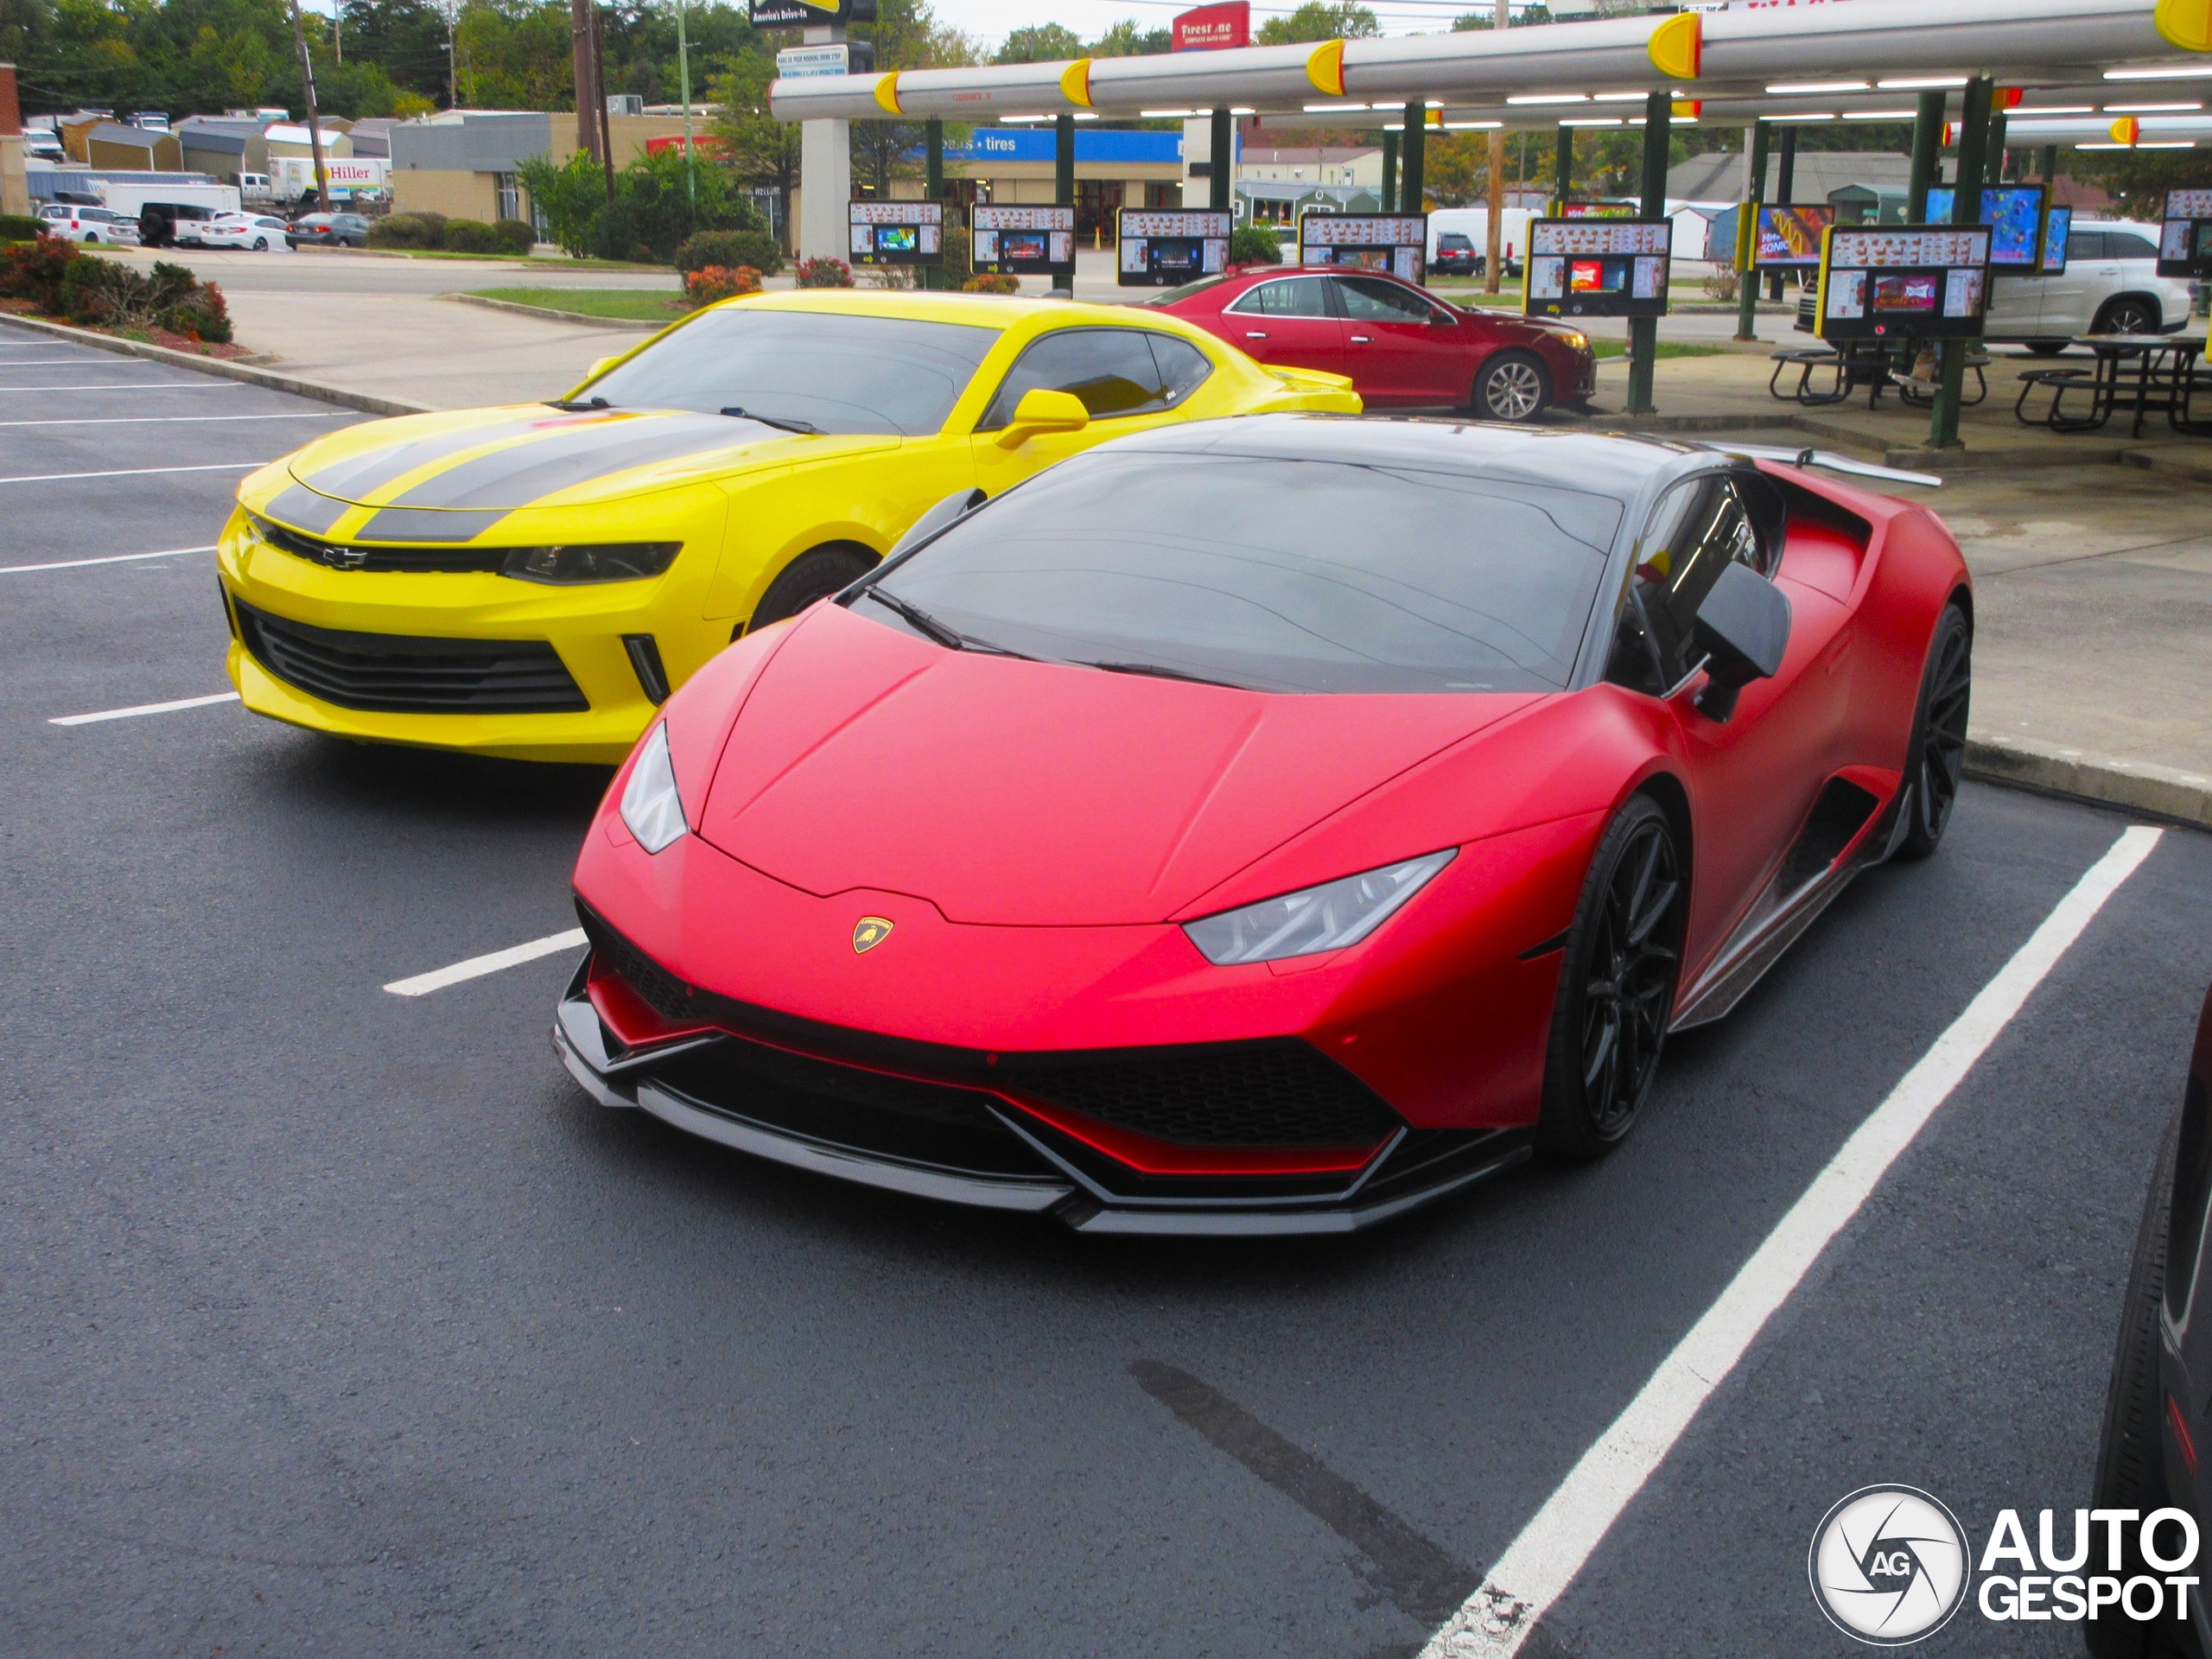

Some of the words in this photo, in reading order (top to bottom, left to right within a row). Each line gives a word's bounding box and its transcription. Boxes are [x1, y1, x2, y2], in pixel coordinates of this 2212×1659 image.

[753, 9, 780, 22] America's
[781, 7, 808, 21] Drive-In
[1181, 22, 1231, 38] Firestne
[986, 137, 1015, 150] tires
[330, 167, 370, 179] Hiller
[1761, 241, 1789, 254] SONIC
